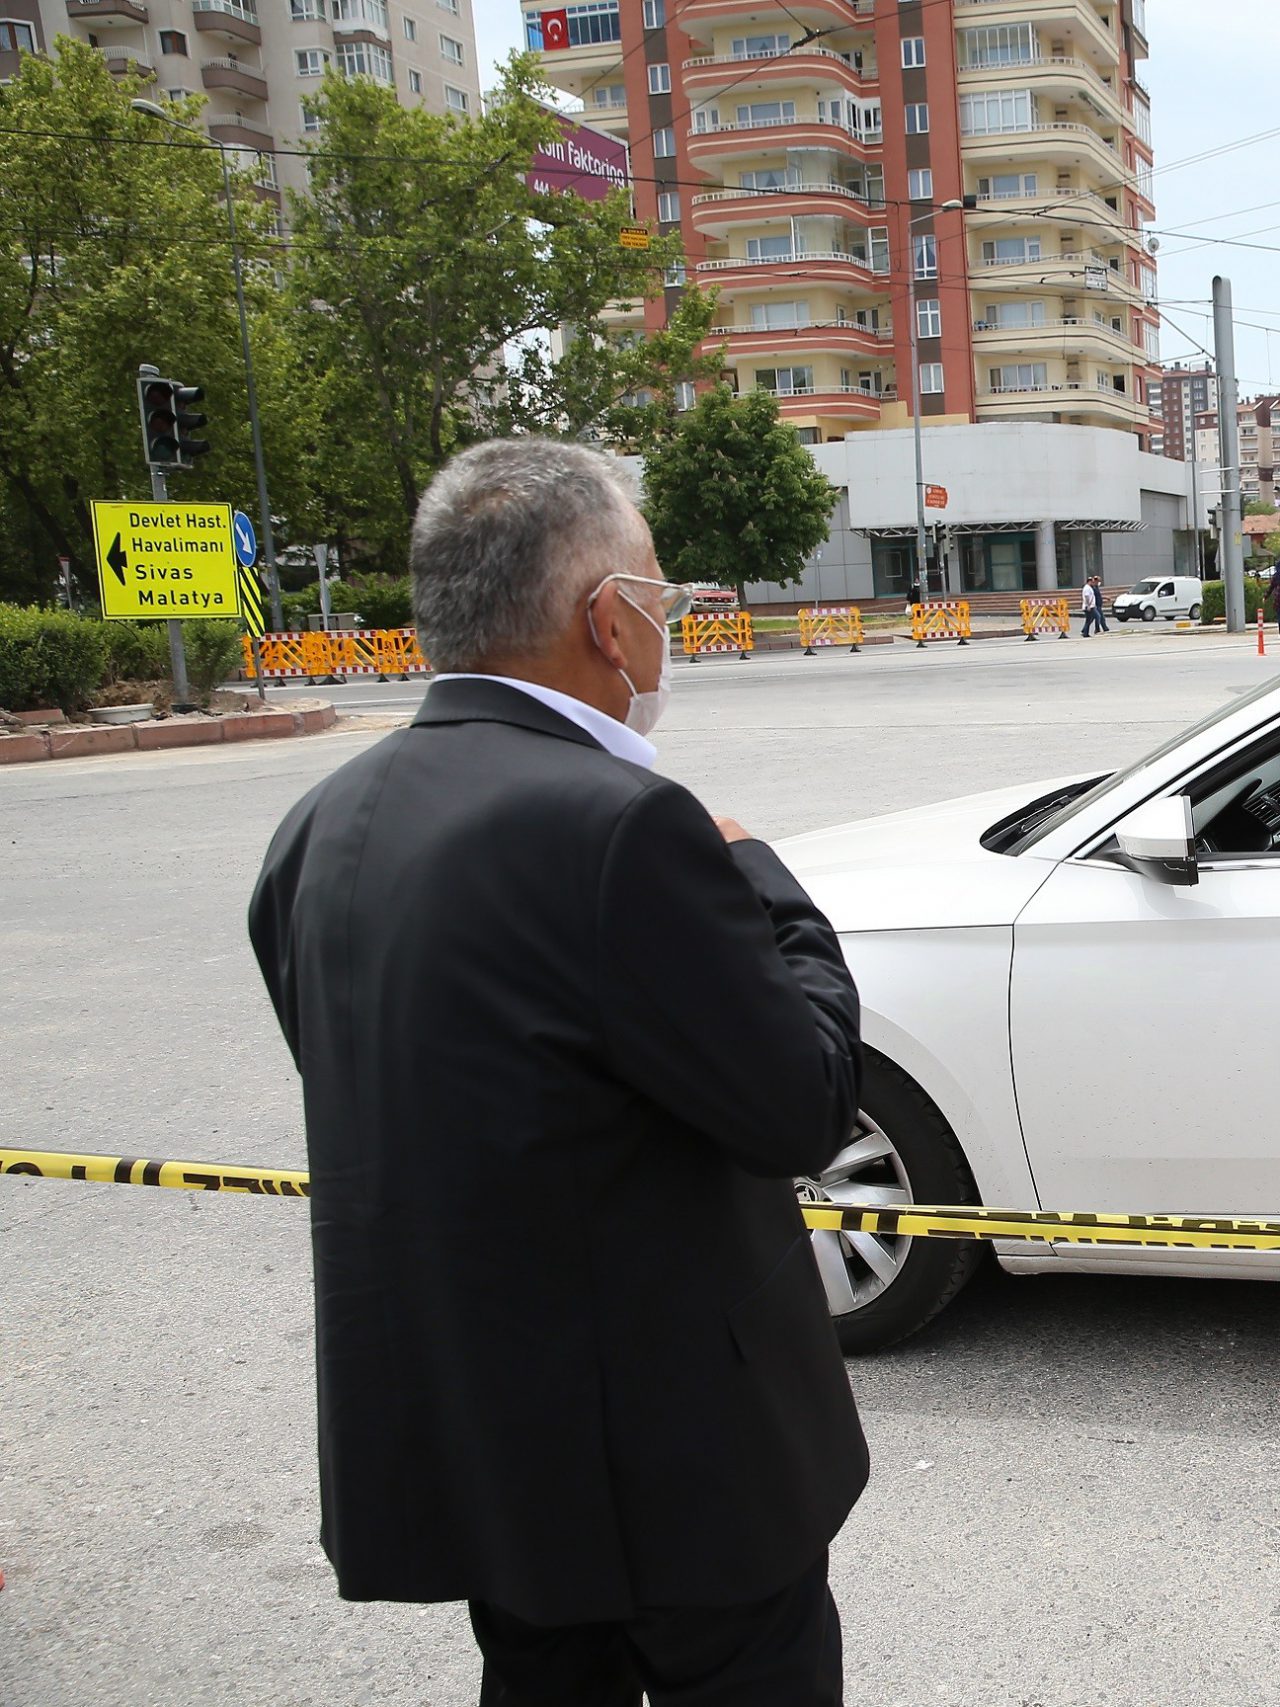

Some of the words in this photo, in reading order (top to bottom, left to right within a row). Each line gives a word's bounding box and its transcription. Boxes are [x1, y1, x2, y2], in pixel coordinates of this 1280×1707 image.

[567, 140, 625, 192] faktoring
[129, 512, 181, 529] Devlet
[186, 513, 227, 529] Hast.
[132, 537, 224, 553] Havalimanı
[135, 564, 193, 580] Sivas
[138, 590, 224, 608] Malatya
